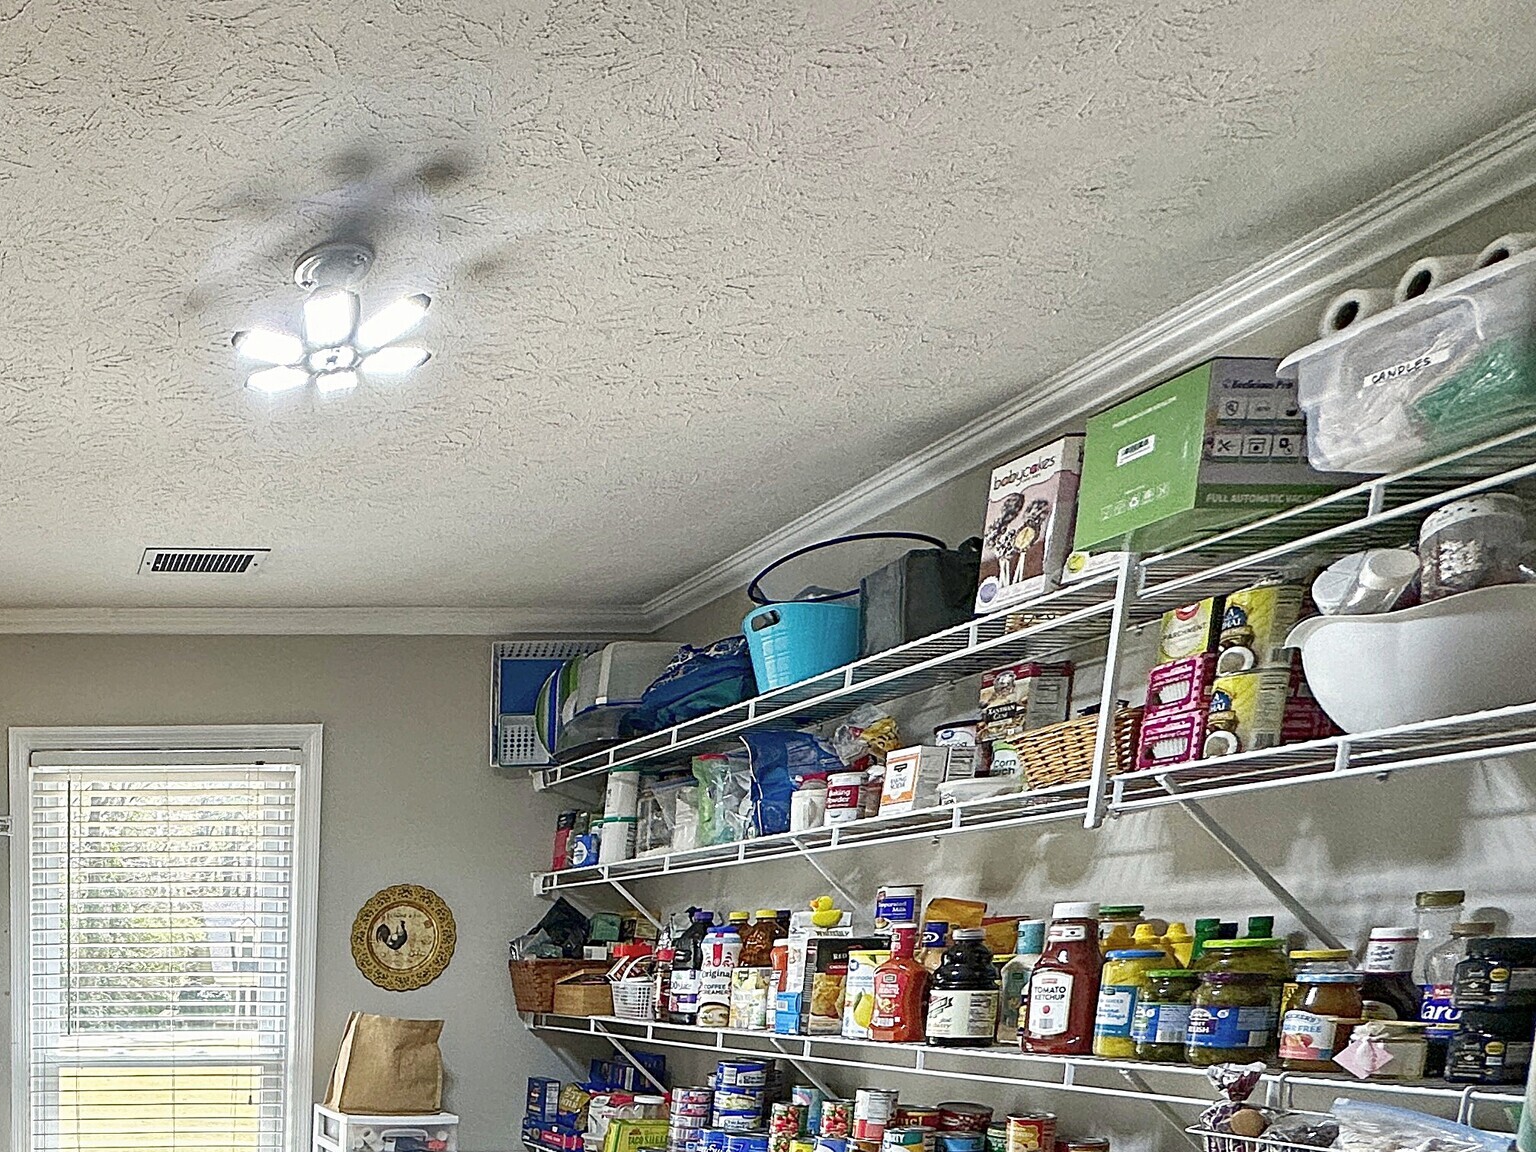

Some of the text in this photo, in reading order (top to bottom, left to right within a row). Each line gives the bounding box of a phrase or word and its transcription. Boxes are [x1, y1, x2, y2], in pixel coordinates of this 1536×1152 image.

[1372, 356, 1431, 384] CANDLES
[993, 456, 1056, 490] babycakes
[1232, 493, 1285, 502] AUTOMATIC
[1034, 986, 1067, 994] TOMATO
[1034, 993, 1066, 1001] KETCHUP
[1297, 1025, 1322, 1033] FREE
